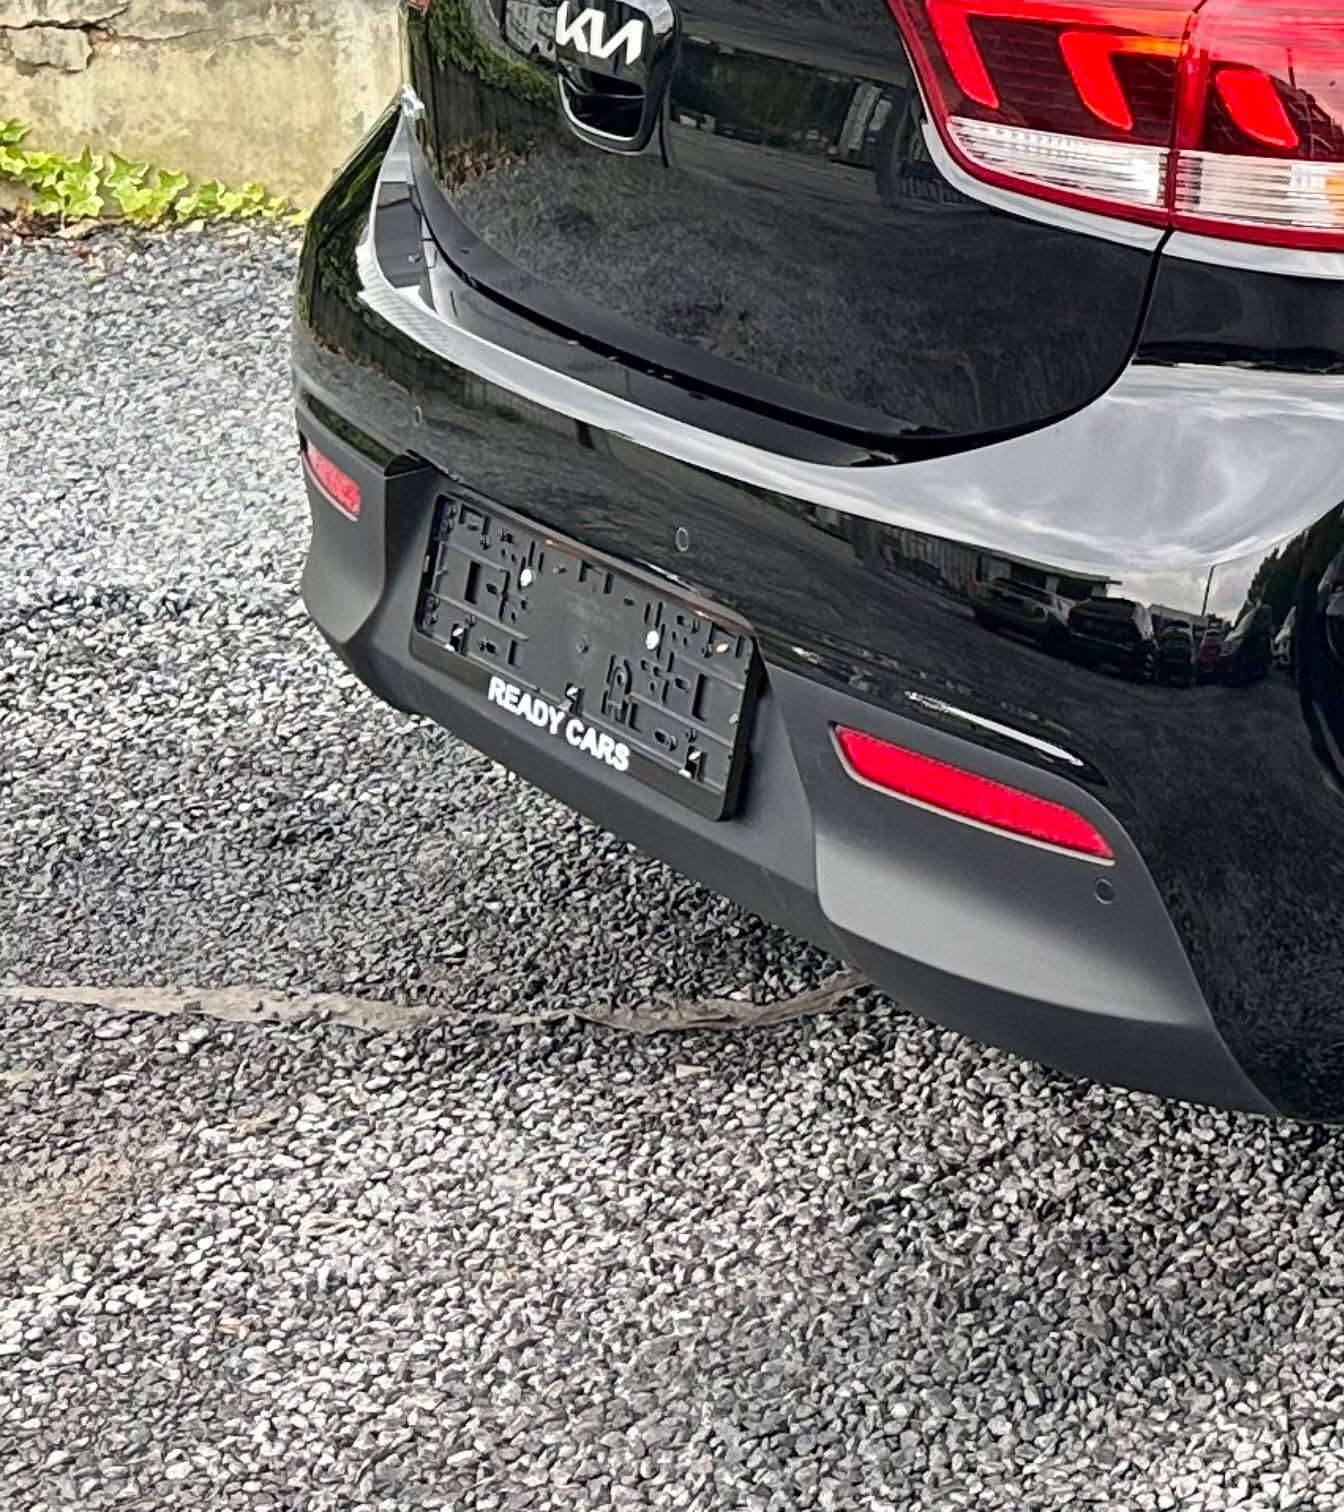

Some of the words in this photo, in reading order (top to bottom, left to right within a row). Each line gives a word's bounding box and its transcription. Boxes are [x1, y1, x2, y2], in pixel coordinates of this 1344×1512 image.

[555, 0, 645, 66] KIA
[488, 676, 565, 735] READY
[566, 719, 631, 771] CARS
